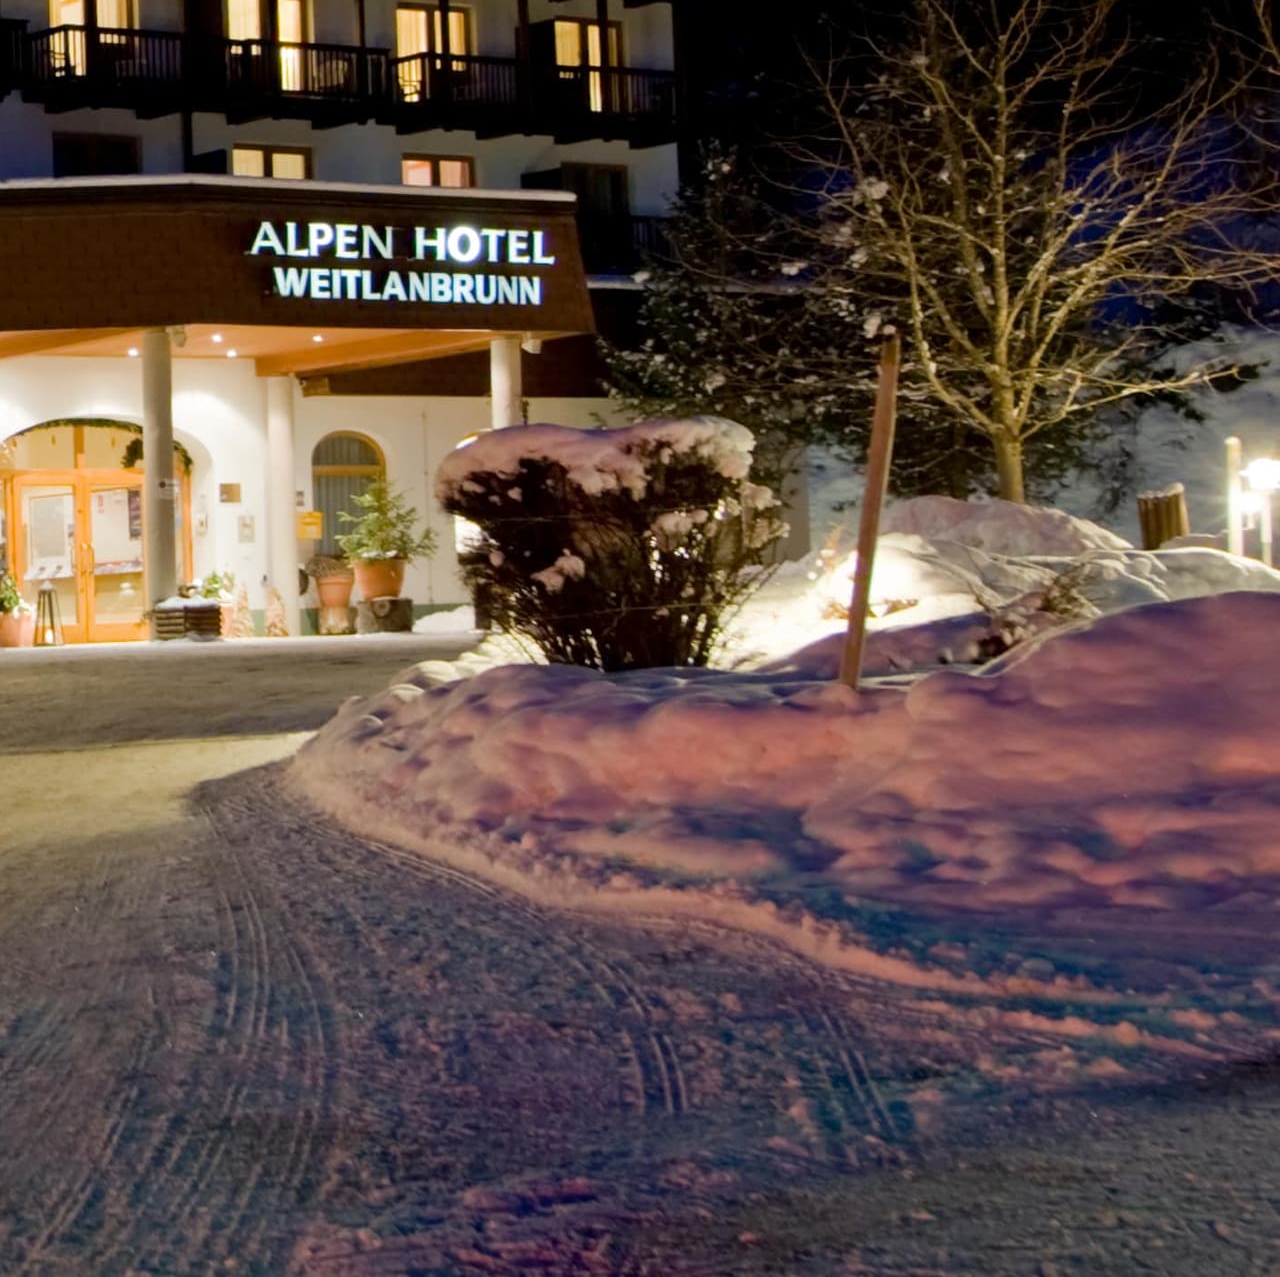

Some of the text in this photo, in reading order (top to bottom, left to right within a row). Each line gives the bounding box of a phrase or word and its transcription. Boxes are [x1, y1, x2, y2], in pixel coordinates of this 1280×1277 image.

[250, 221, 556, 265] ALPEN HOTEL
[273, 266, 541, 306] WEITLANBRUNN
